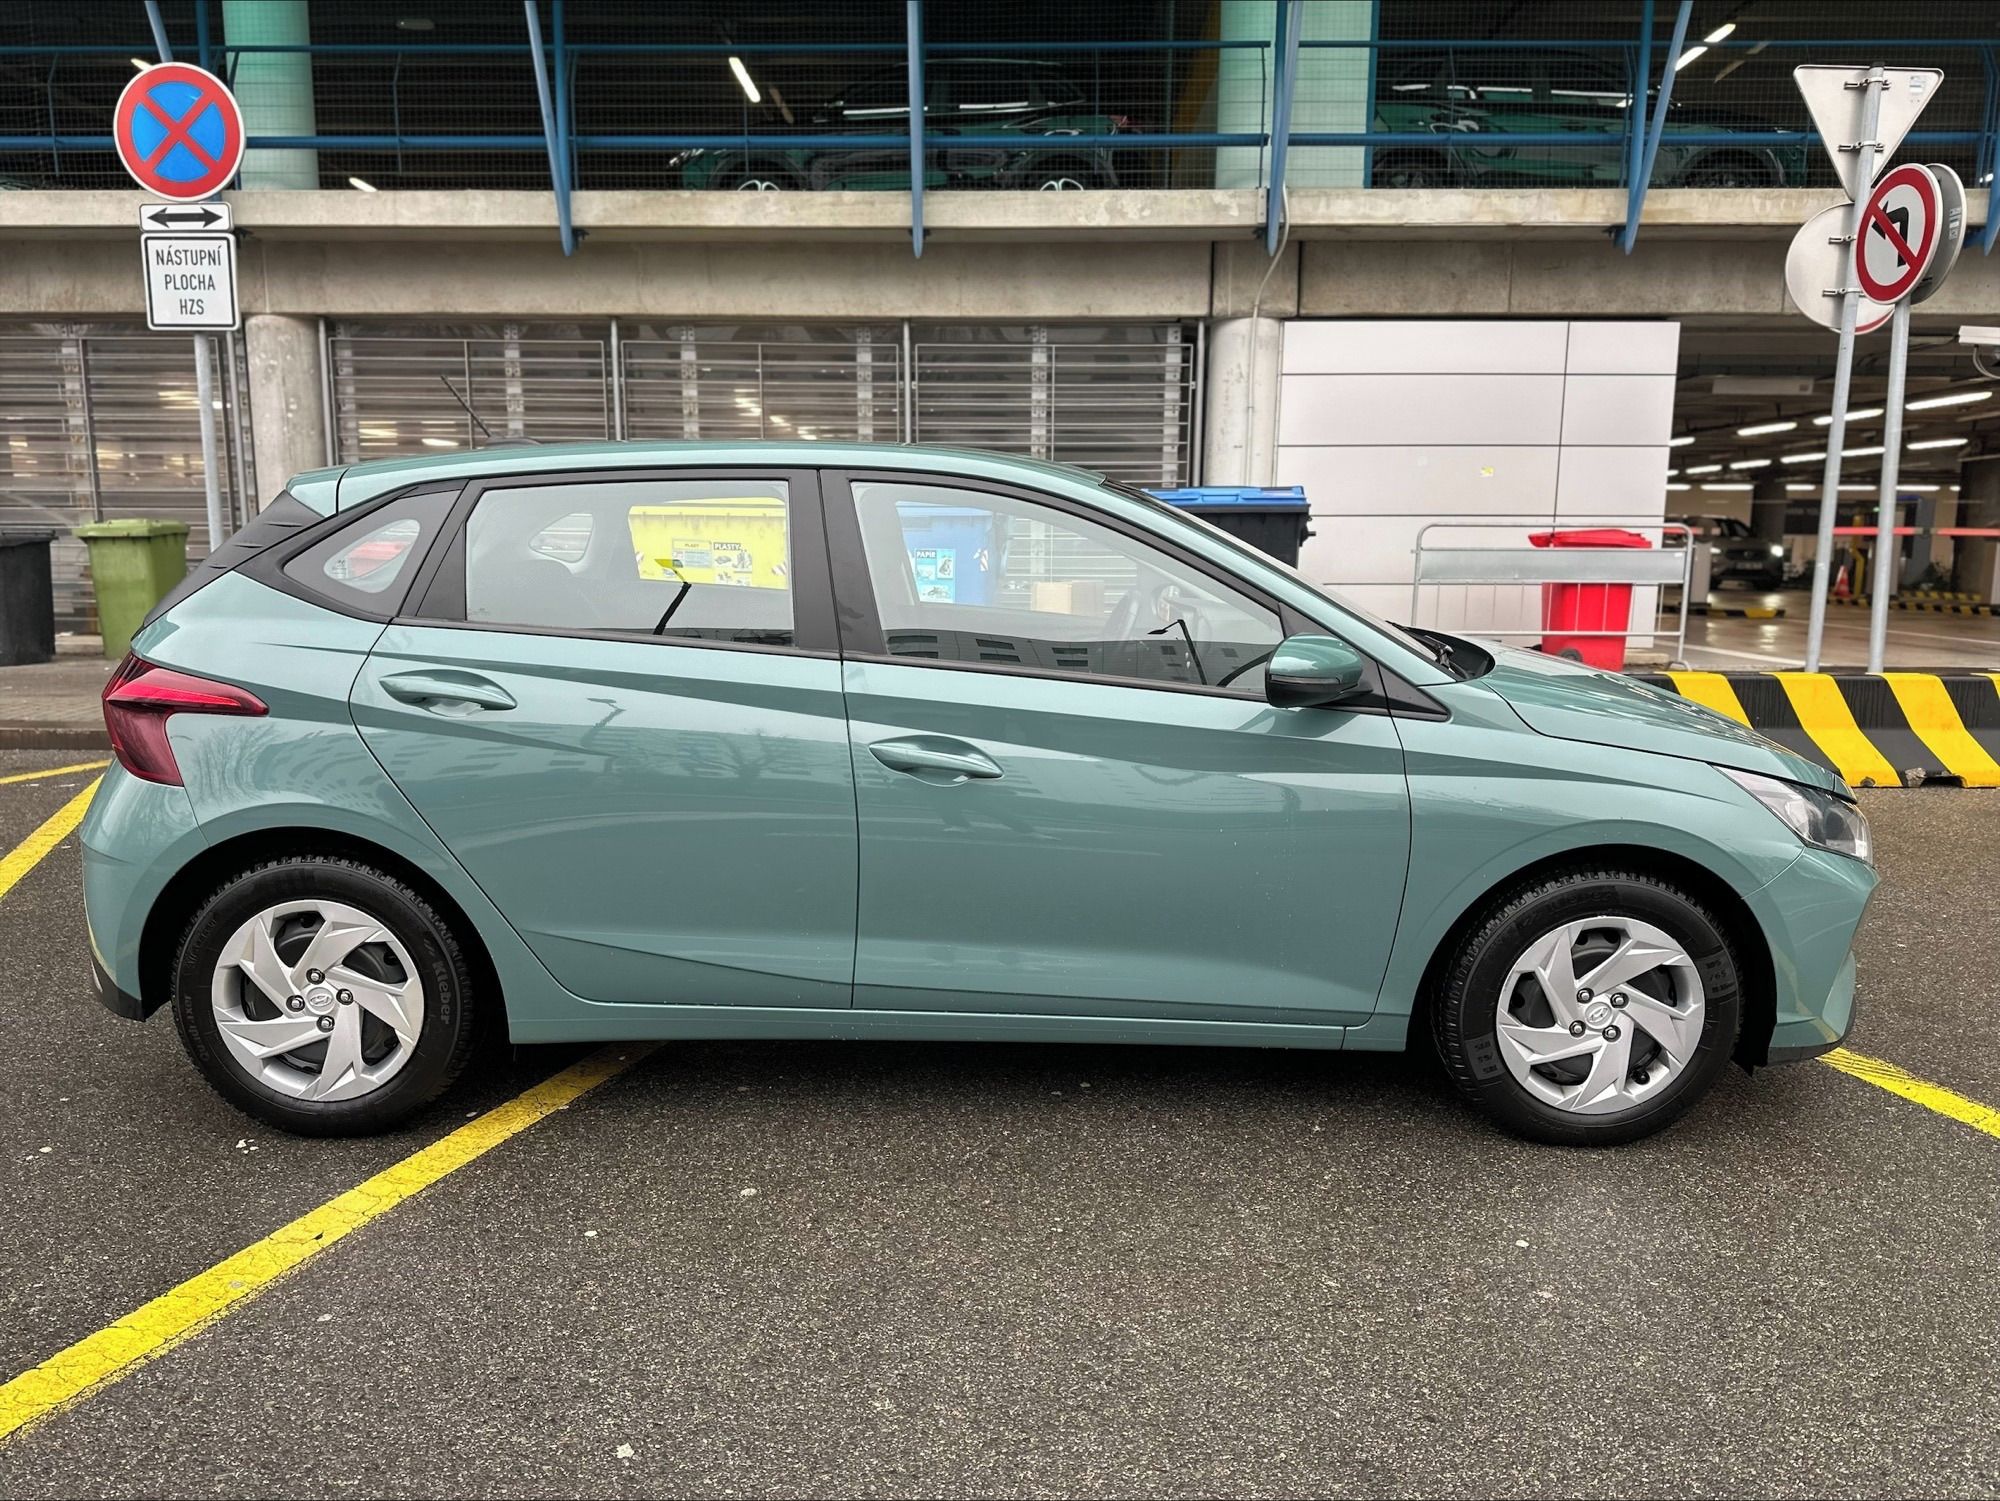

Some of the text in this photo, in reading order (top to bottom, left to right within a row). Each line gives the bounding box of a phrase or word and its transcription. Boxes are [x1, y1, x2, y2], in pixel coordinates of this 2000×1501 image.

[155, 245, 222, 266] NÁSTUPNÍ
[164, 274, 216, 291] PLOCHA
[179, 298, 205, 315] HZS
[432, 961, 451, 1024] Kleber
